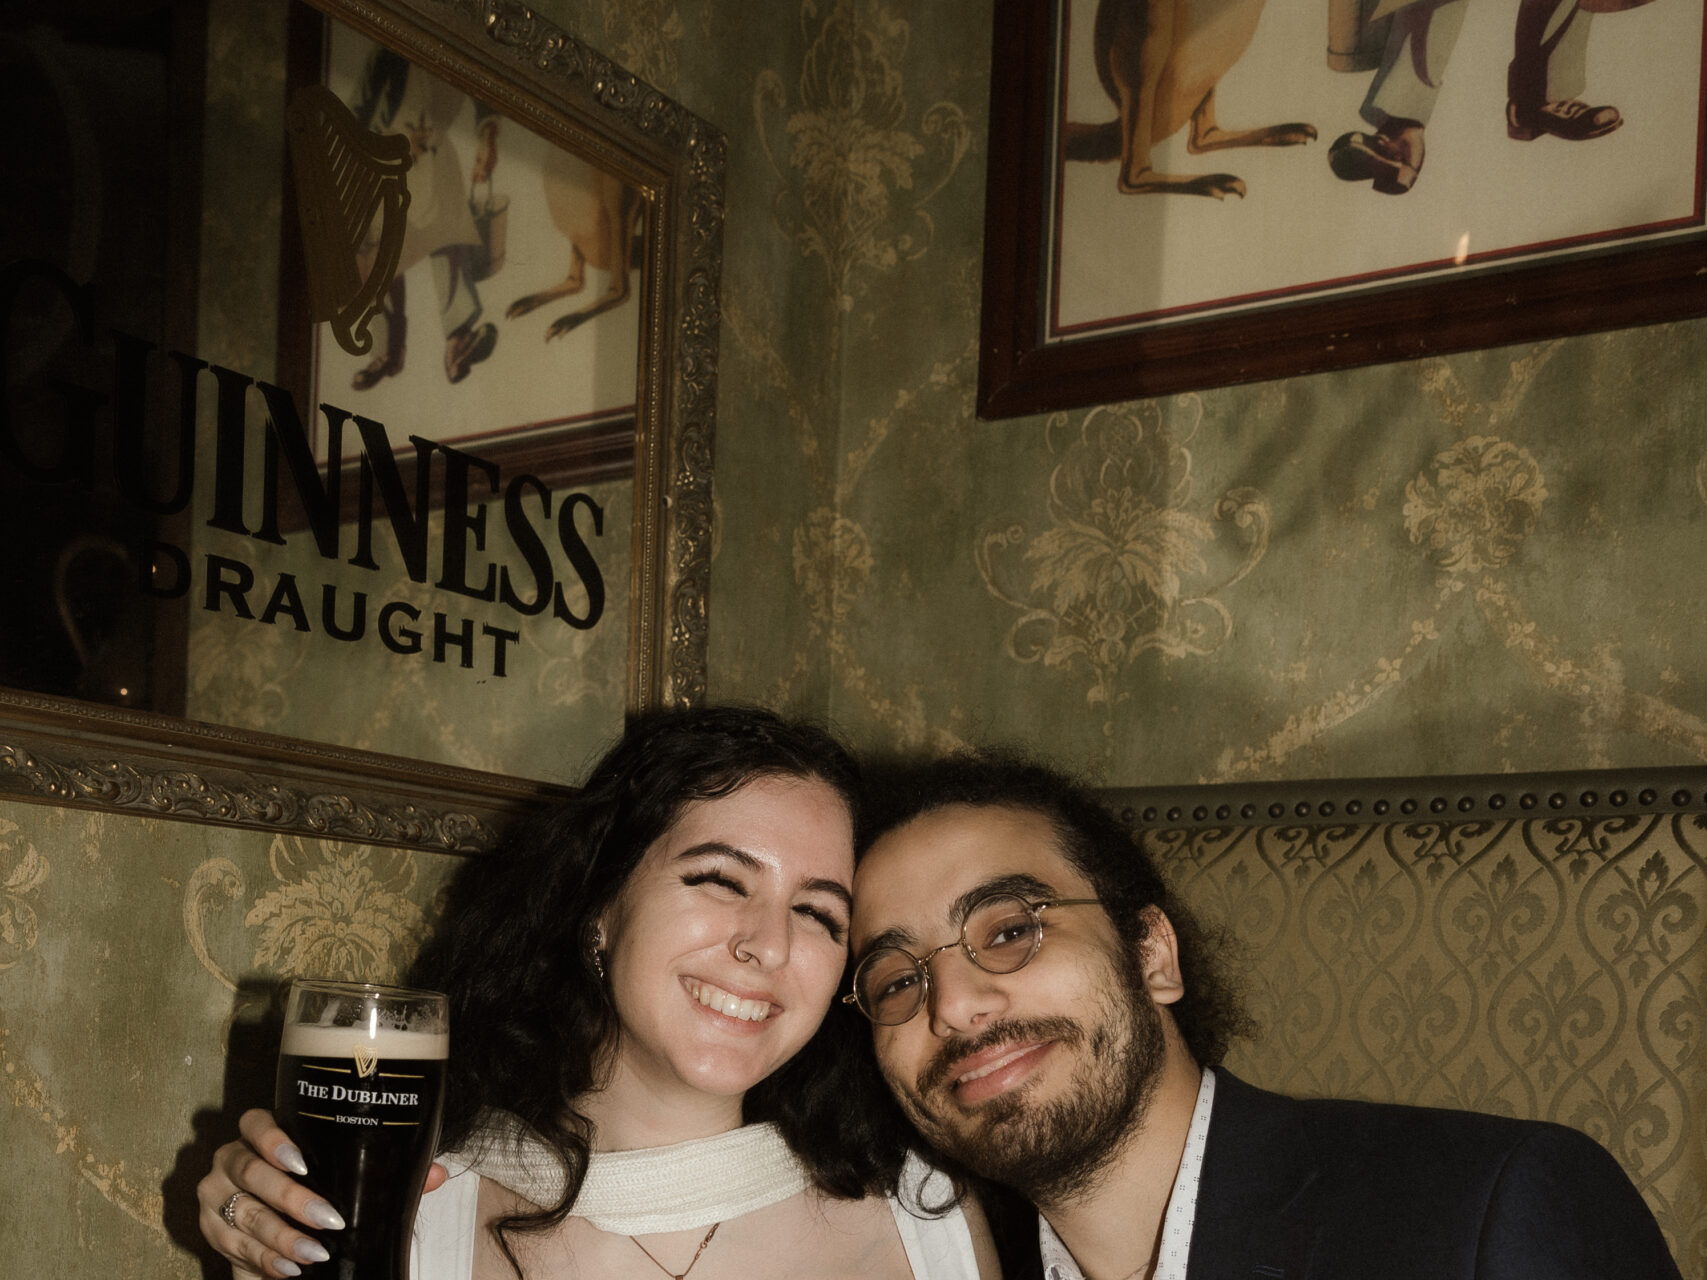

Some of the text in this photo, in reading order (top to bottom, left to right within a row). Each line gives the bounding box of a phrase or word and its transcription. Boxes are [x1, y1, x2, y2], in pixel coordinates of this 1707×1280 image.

[0, 258, 605, 629] GUINNESS
[139, 541, 520, 677] DRAUGHT
[298, 1080, 419, 1106] THE DUBLINER
[336, 1115, 379, 1126] BOSTON
